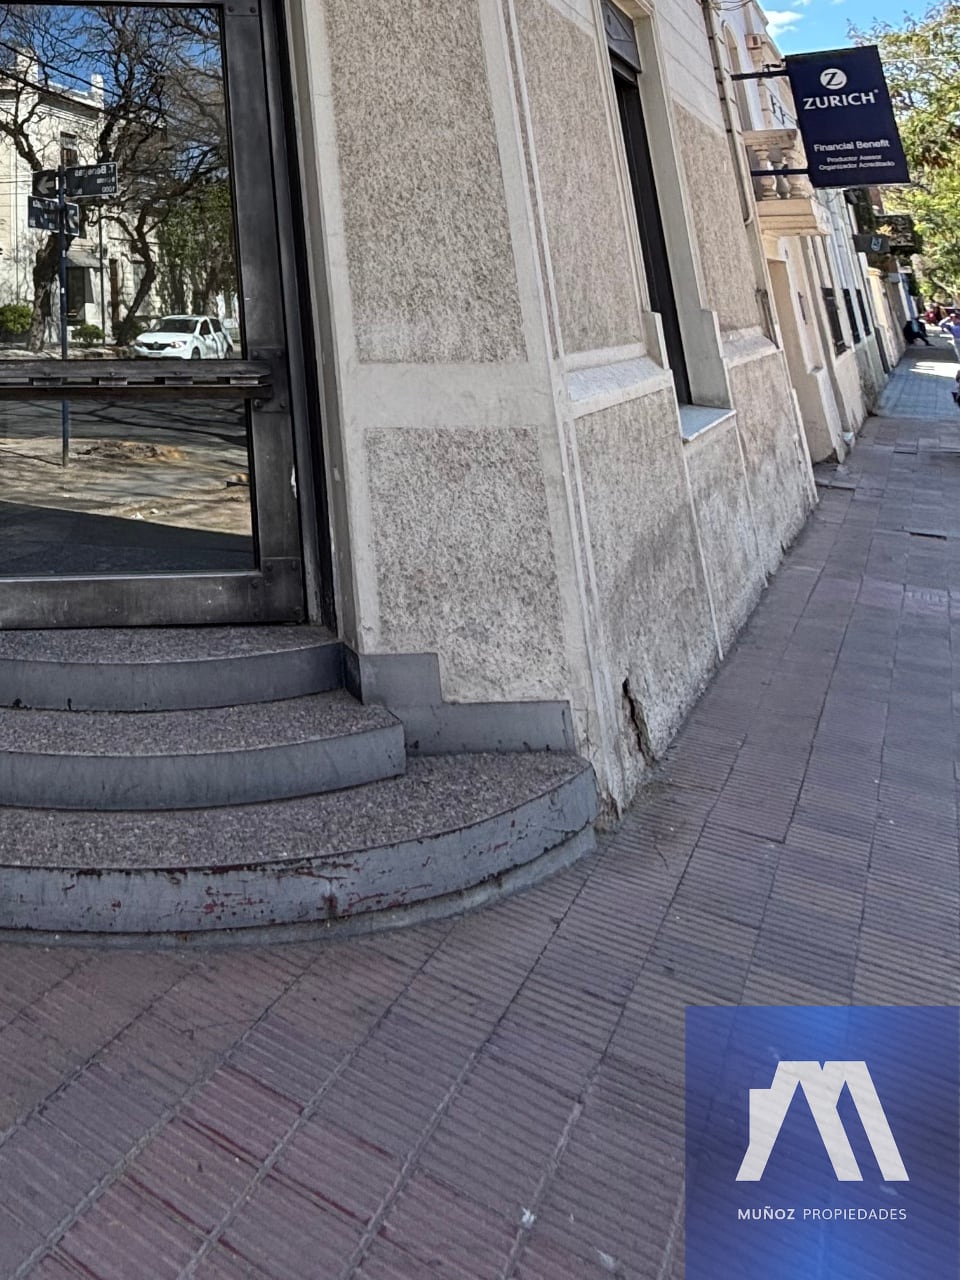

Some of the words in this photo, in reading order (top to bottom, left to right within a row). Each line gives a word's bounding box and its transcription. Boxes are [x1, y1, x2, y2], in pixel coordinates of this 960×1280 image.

[803, 92, 876, 110] ZURICH
[813, 142, 854, 152] Financial
[855, 139, 890, 149] Benefit
